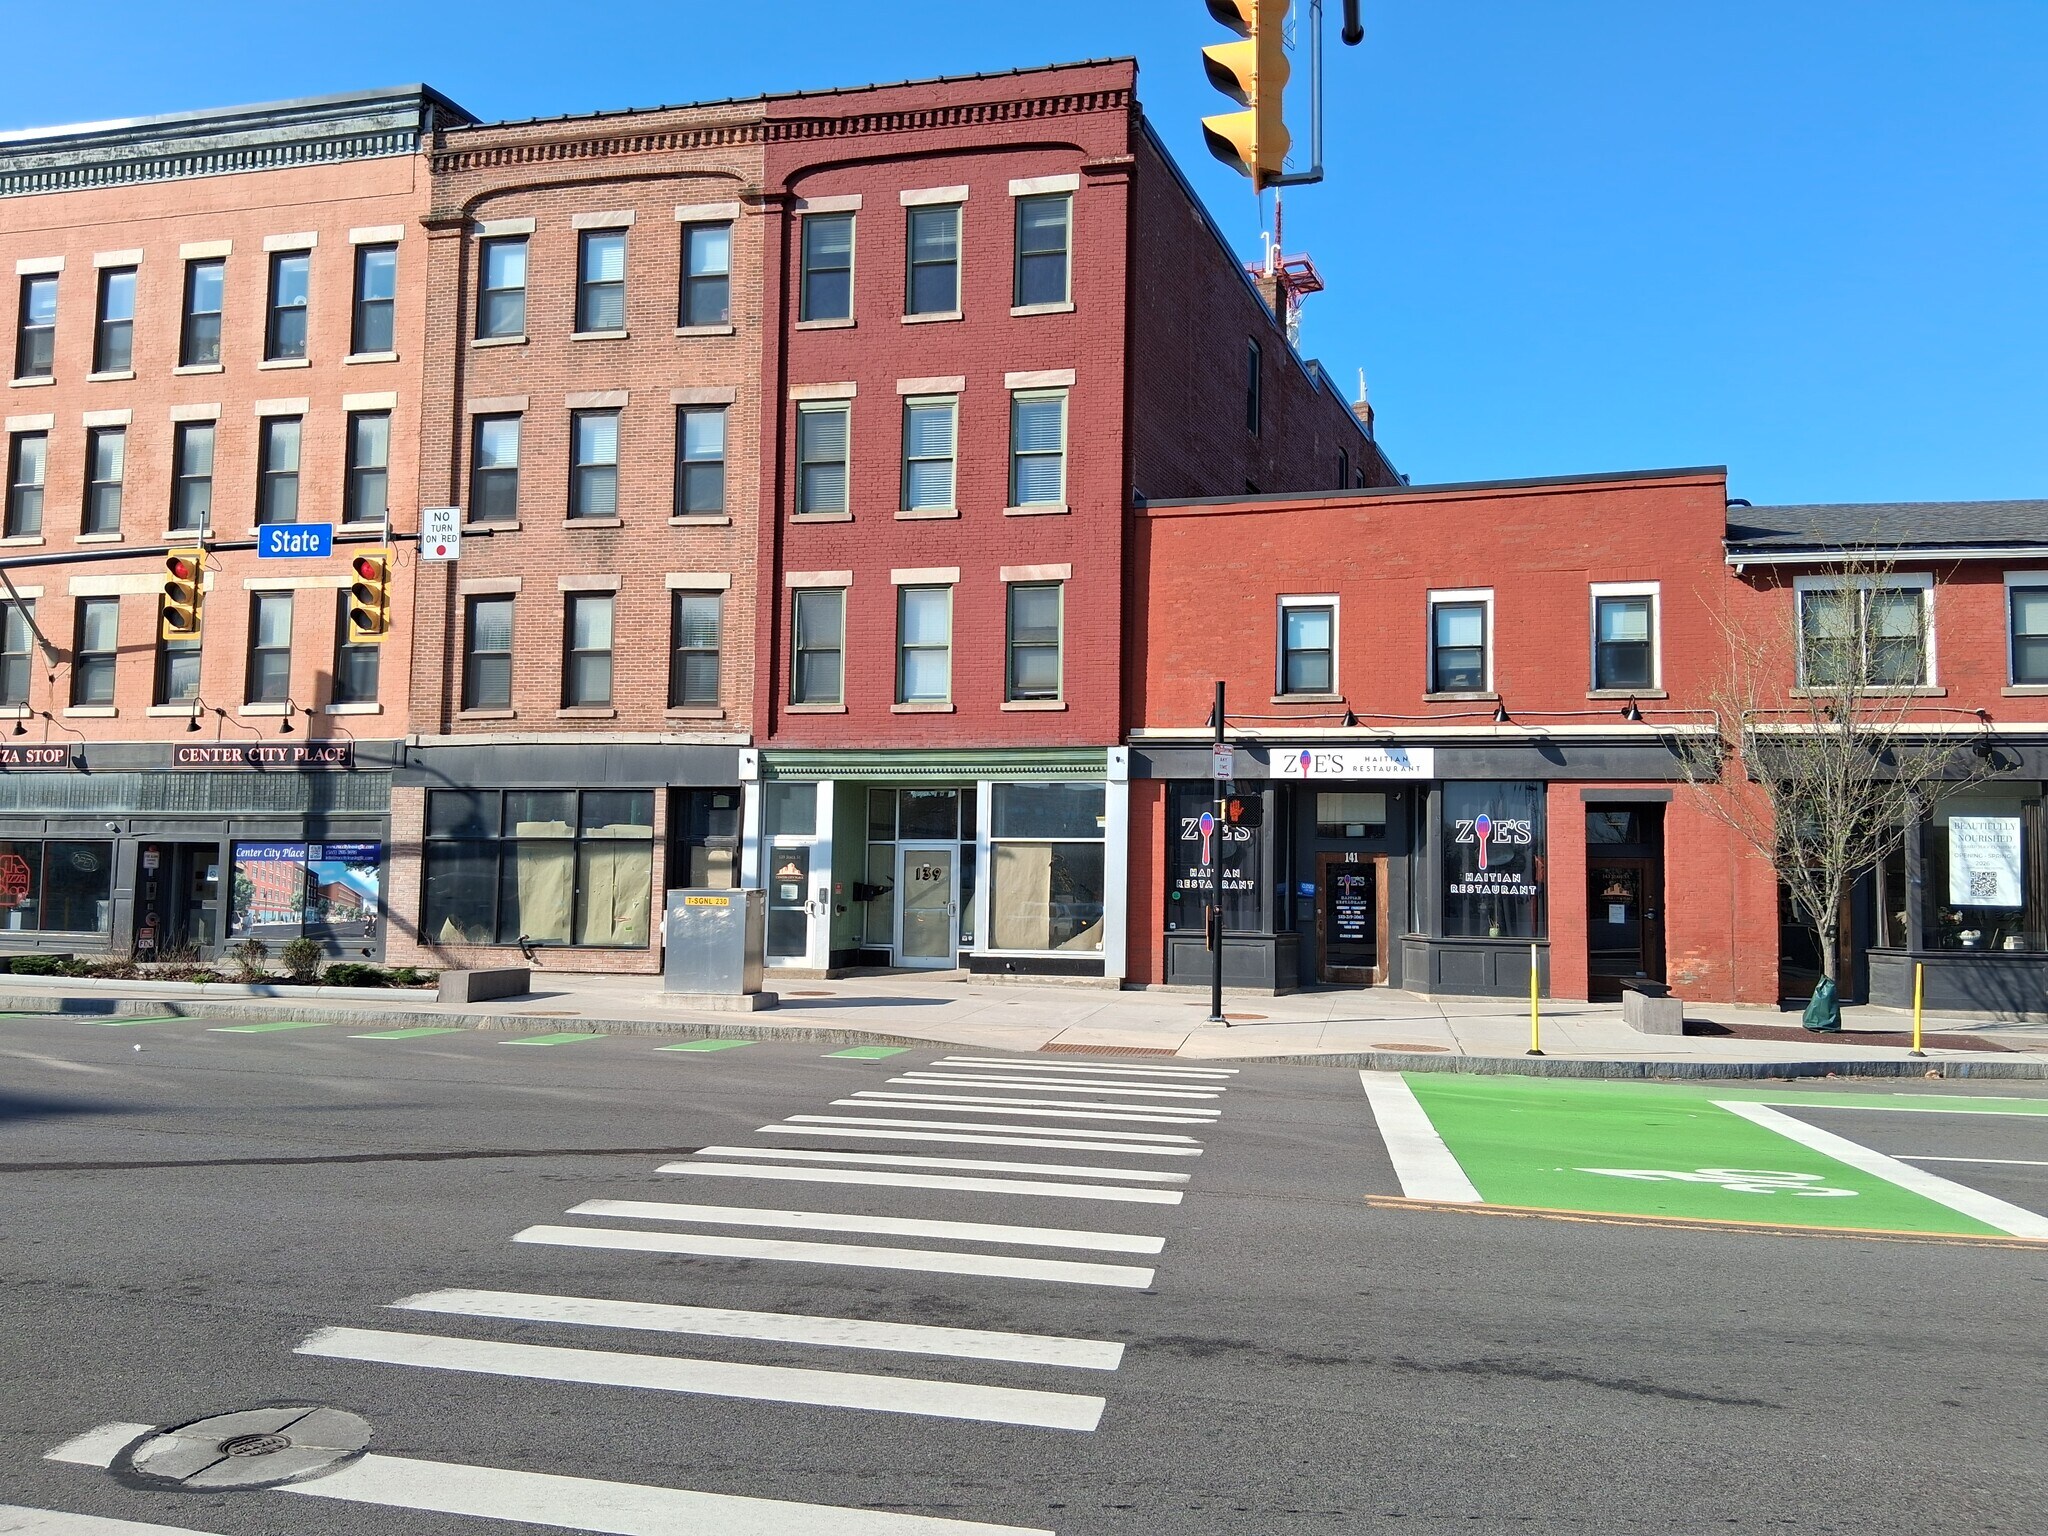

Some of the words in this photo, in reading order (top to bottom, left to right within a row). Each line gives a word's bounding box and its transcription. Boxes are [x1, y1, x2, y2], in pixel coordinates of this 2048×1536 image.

[434, 512, 450, 521] NO
[431, 524, 453, 532] TURN
[270, 529, 320, 553] State
[426, 535, 437, 543] ON
[441, 534, 458, 542] RED
[26, 749, 64, 762] STOP
[178, 748, 243, 762] CENTER
[248, 748, 288, 762] CITY
[293, 748, 346, 762] PLACE
[1954, 822, 2016, 831] BEAUTIFULLY
[1958, 834, 2013, 843] NOURISHED
[236, 847, 262, 858] Center
[263, 847, 281, 861] City
[282, 847, 305, 858] Place
[1344, 852, 1359, 863] 141
[916, 867, 941, 880] 139
[1465, 873, 1521, 882] HAITIAN
[1176, 879, 1254, 890] RESTARANT
[1450, 884, 1536, 895] RESTAURANT
